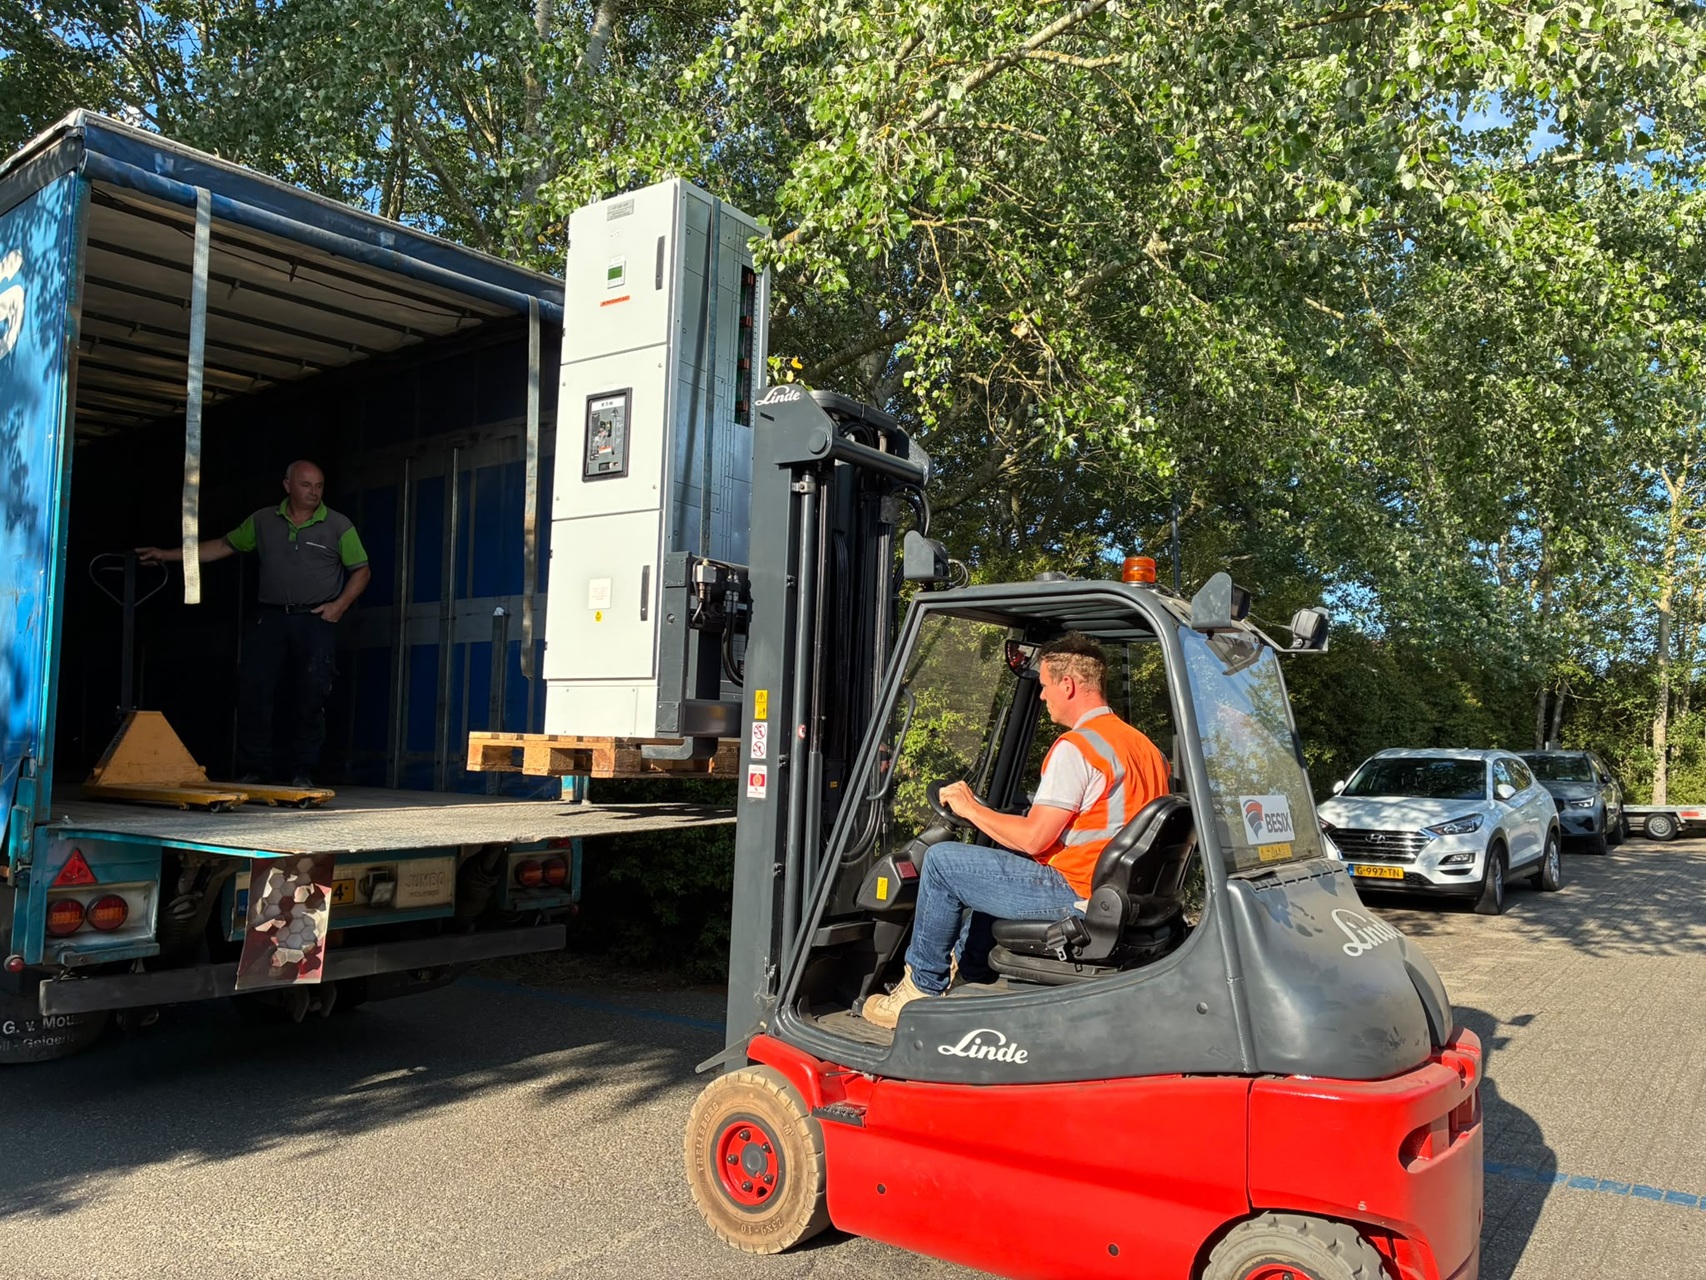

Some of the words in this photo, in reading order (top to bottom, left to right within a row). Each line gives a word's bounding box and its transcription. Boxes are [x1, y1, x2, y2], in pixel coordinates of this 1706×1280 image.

[755, 385, 800, 406] Linde
[1265, 812, 1292, 833] BESIX
[1356, 866, 1400, 878] G-997-TN
[937, 1028, 1029, 1064] Linde
[696, 1101, 720, 1172] TRELLEBORG
